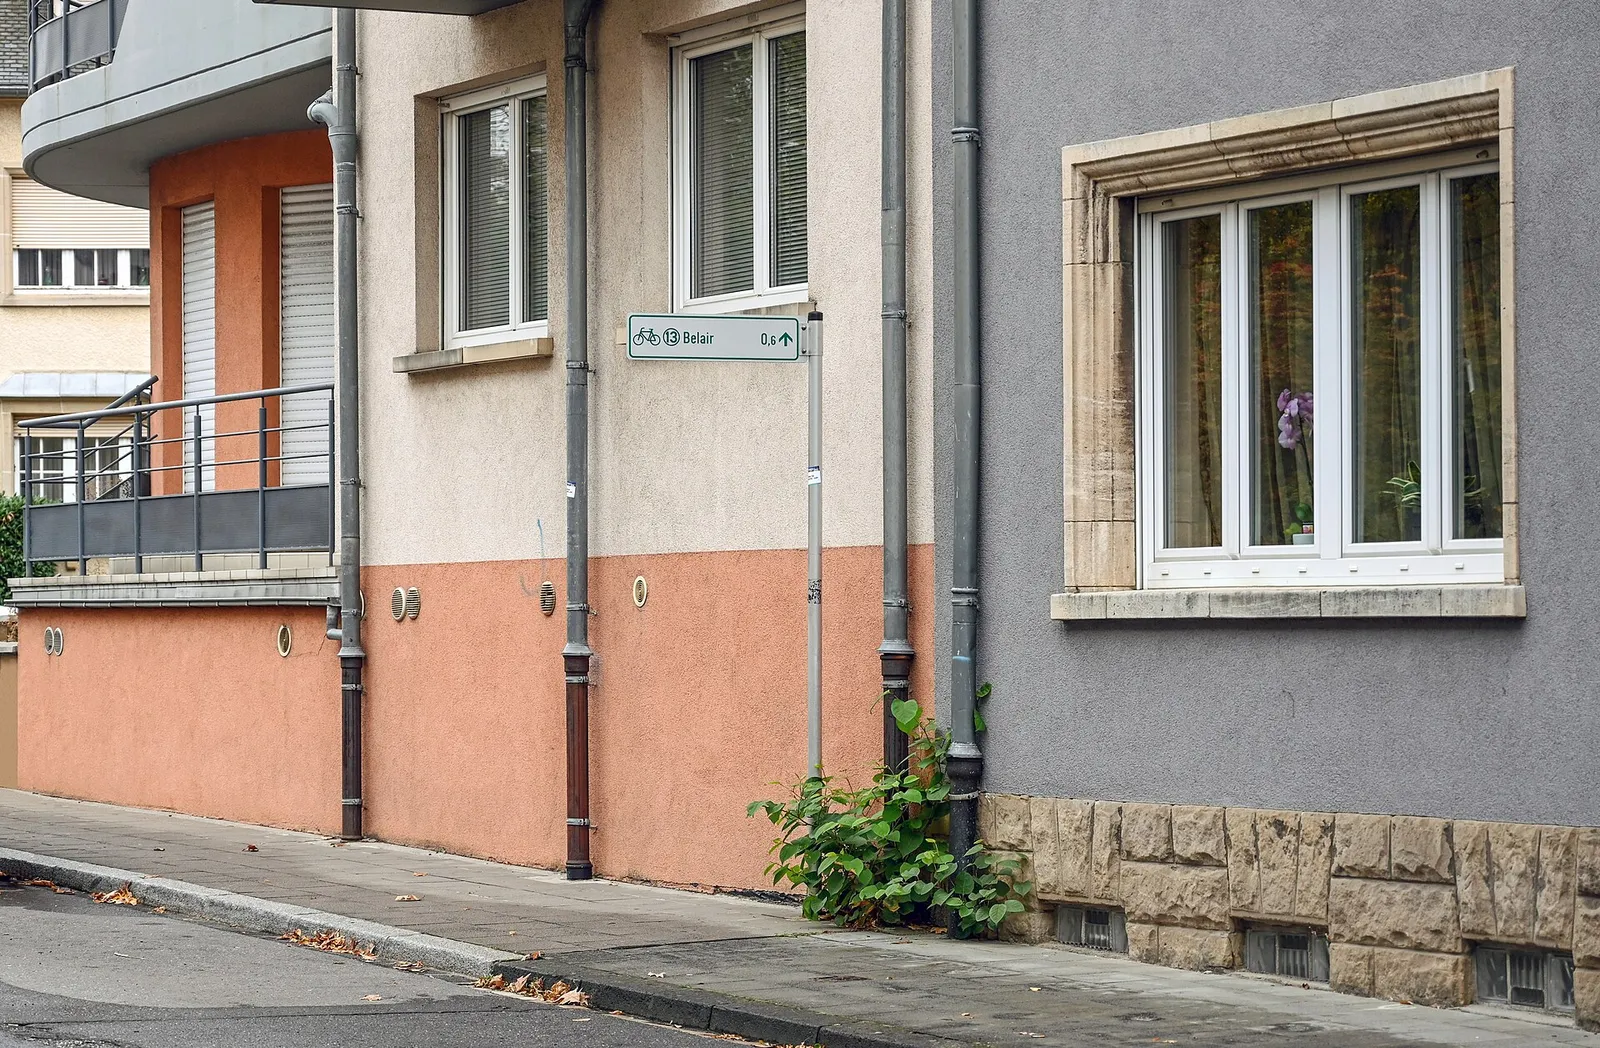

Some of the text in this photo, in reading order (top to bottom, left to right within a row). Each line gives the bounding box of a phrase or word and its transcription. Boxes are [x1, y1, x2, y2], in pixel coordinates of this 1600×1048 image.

[665, 331, 776, 346] 13 Belair 0,6
